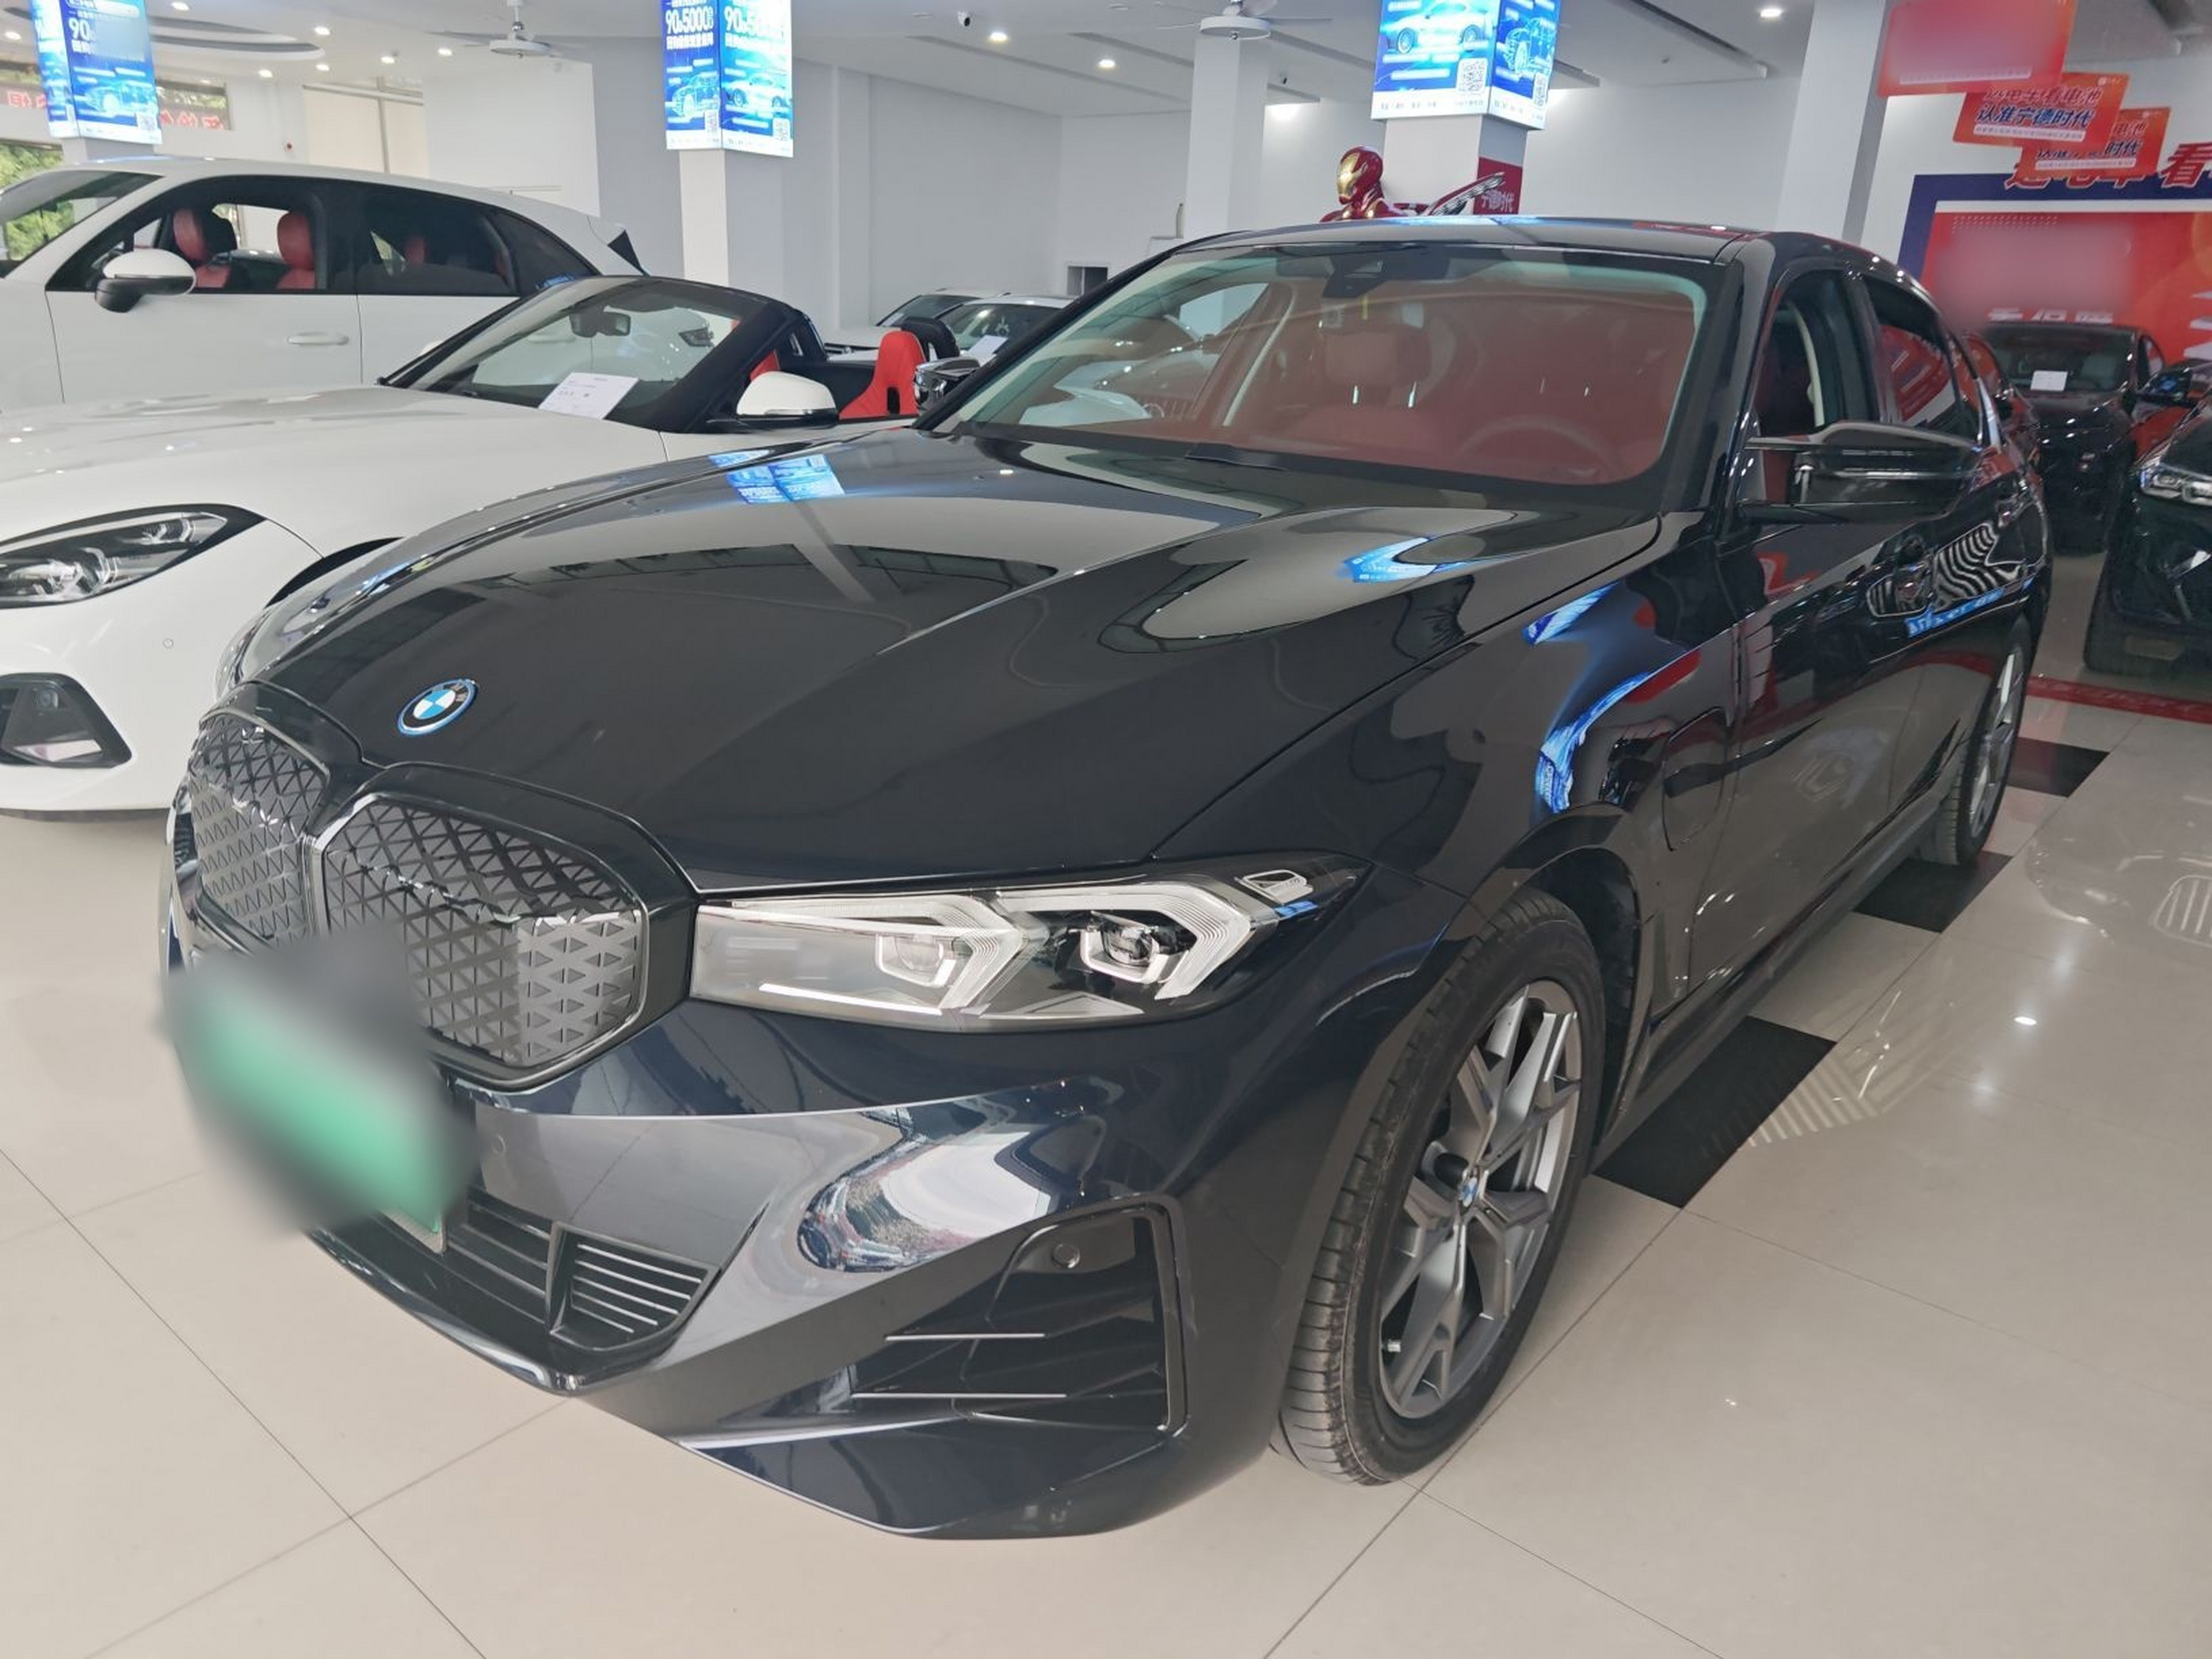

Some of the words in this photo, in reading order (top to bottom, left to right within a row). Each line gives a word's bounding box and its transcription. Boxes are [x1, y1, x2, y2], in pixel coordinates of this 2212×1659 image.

[1976, 104, 2095, 129] 认准宁德时代
